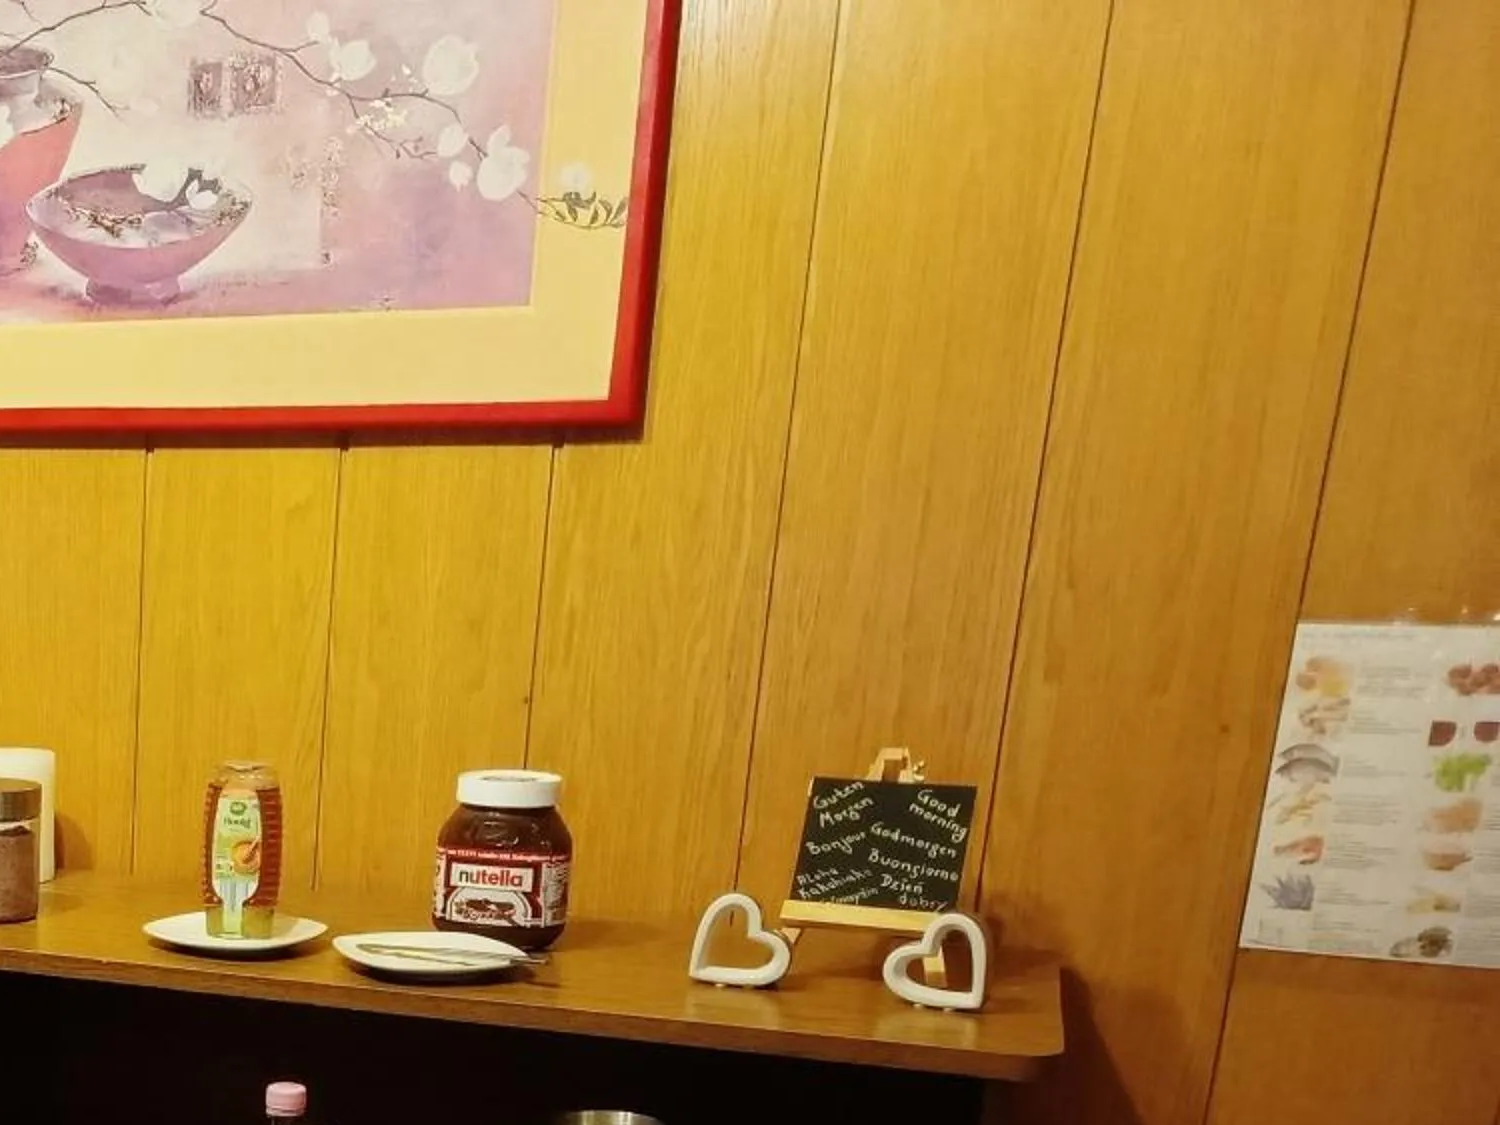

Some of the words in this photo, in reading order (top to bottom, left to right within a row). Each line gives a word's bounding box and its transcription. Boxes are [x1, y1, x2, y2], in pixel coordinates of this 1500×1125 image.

[813, 781, 865, 810] Guten
[917, 789, 962, 819] Good
[819, 797, 874, 829] Morgen
[909, 802, 968, 843] morning
[805, 831, 866, 855] Bonjour
[458, 869, 524, 888] nutella
[868, 849, 959, 882] Buongiorno
